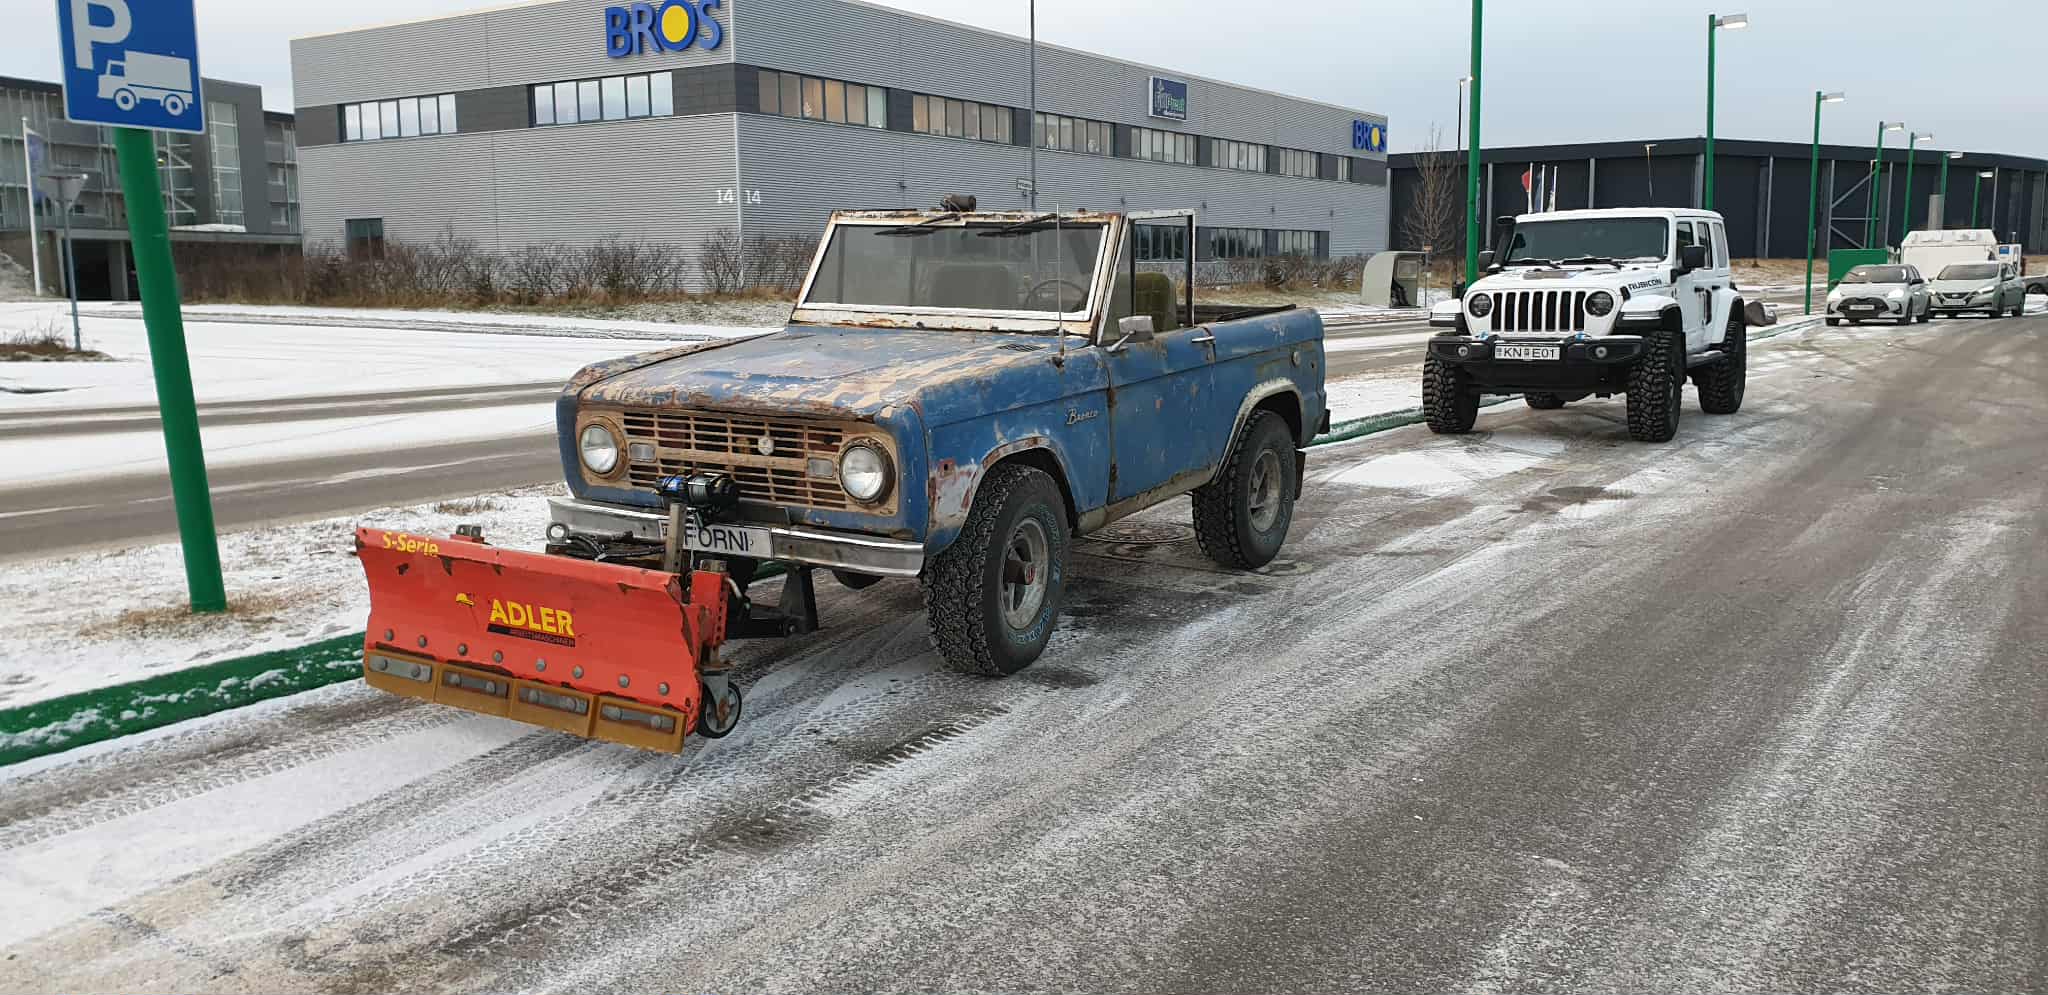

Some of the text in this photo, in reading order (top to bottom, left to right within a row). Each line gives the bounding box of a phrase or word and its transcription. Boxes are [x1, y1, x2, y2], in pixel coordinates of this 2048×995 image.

[70, 0, 132, 70] P
[605, 0, 722, 57] BROS
[1353, 120, 1387, 152] BROS
[716, 190, 734, 203] 14
[745, 190, 761, 204] 14
[1628, 279, 1662, 290] RUBICON
[1504, 347, 1522, 358] KN
[1065, 408, 1098, 425] Bronco
[383, 531, 439, 558] S-Serie
[685, 525, 749, 552] FORNI
[489, 599, 575, 636] ADLER
